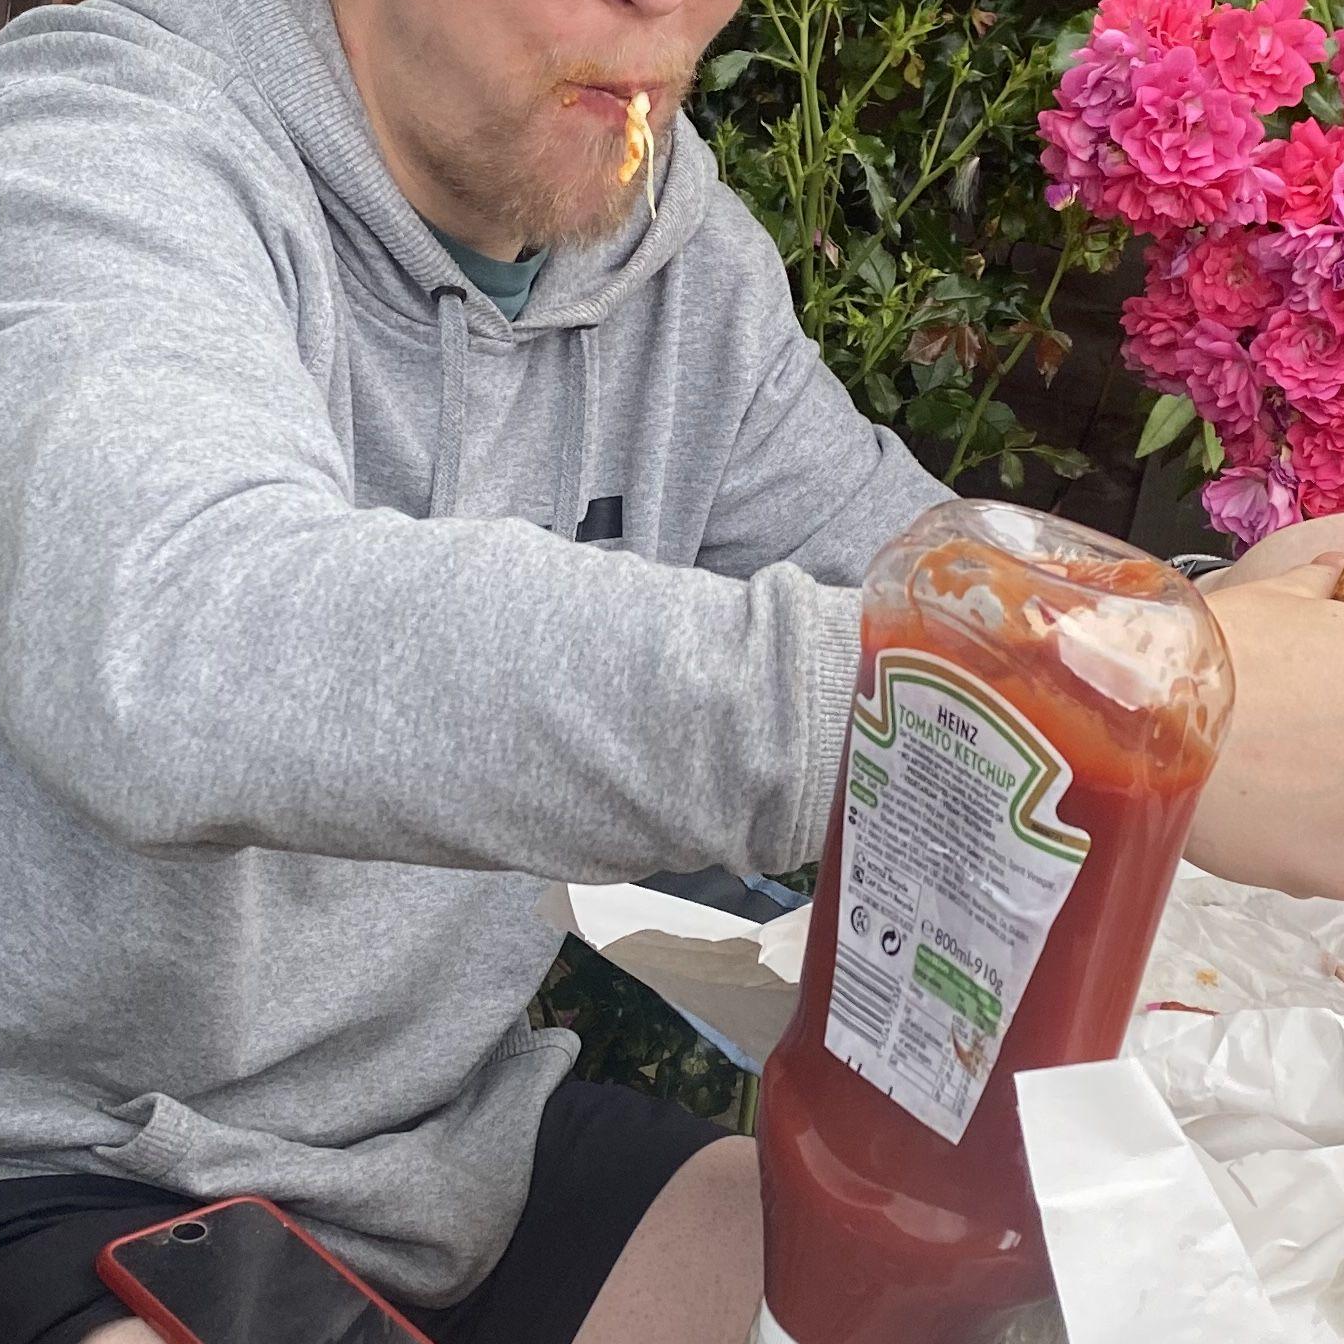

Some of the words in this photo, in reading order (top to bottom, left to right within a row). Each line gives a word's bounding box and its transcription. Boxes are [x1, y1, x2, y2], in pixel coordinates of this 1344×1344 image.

[899, 704, 951, 752] TOMATO
[955, 743, 1016, 792] KETCHUP
[937, 705, 979, 746] HEINZ
